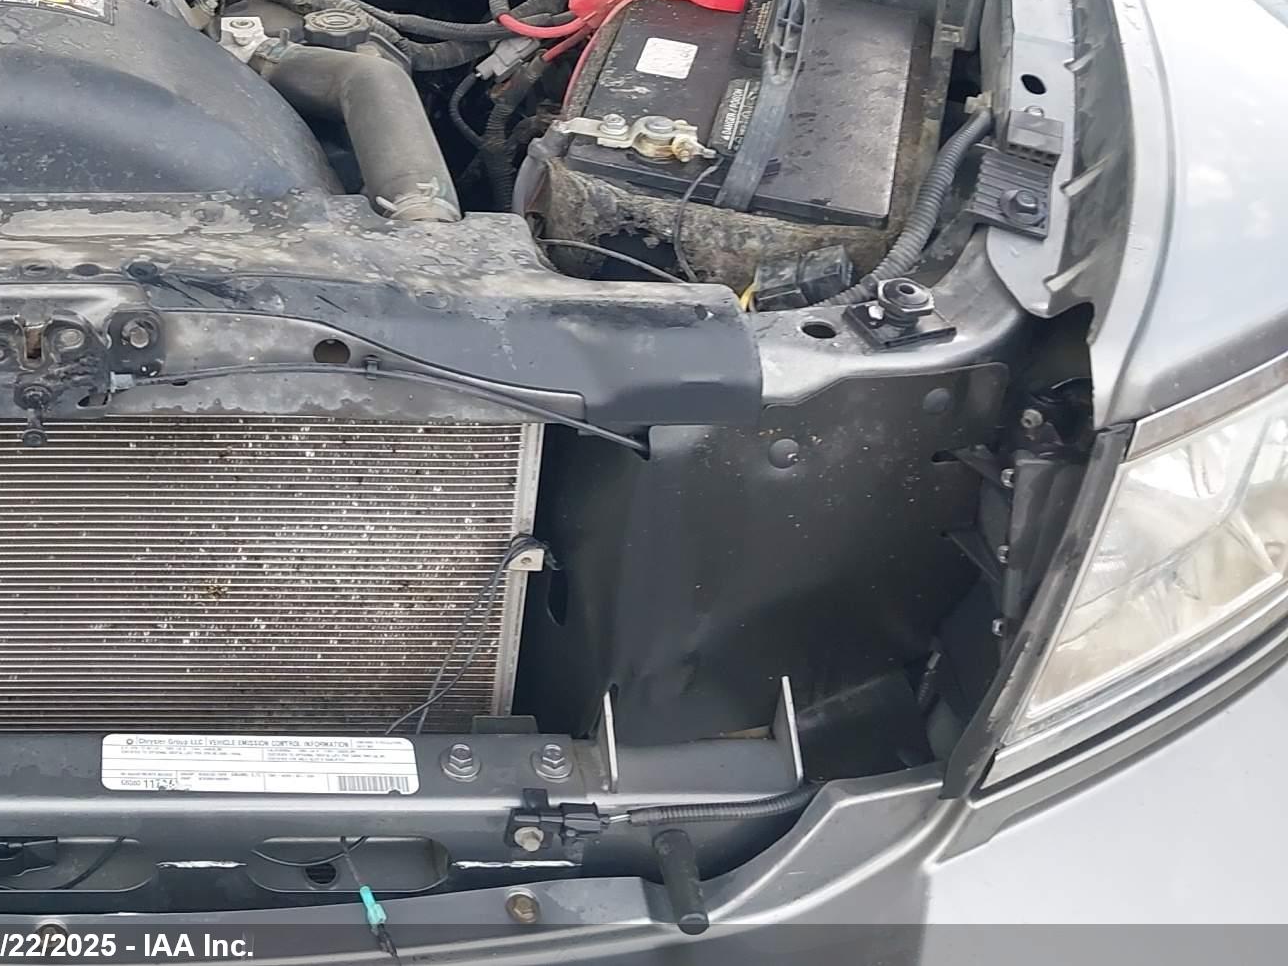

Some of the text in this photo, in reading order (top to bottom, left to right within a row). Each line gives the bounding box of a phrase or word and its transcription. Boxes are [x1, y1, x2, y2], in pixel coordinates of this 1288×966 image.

[168, 738, 189, 747] Group
[190, 738, 204, 746] LLC
[304, 740, 349, 748] INFORMATION
